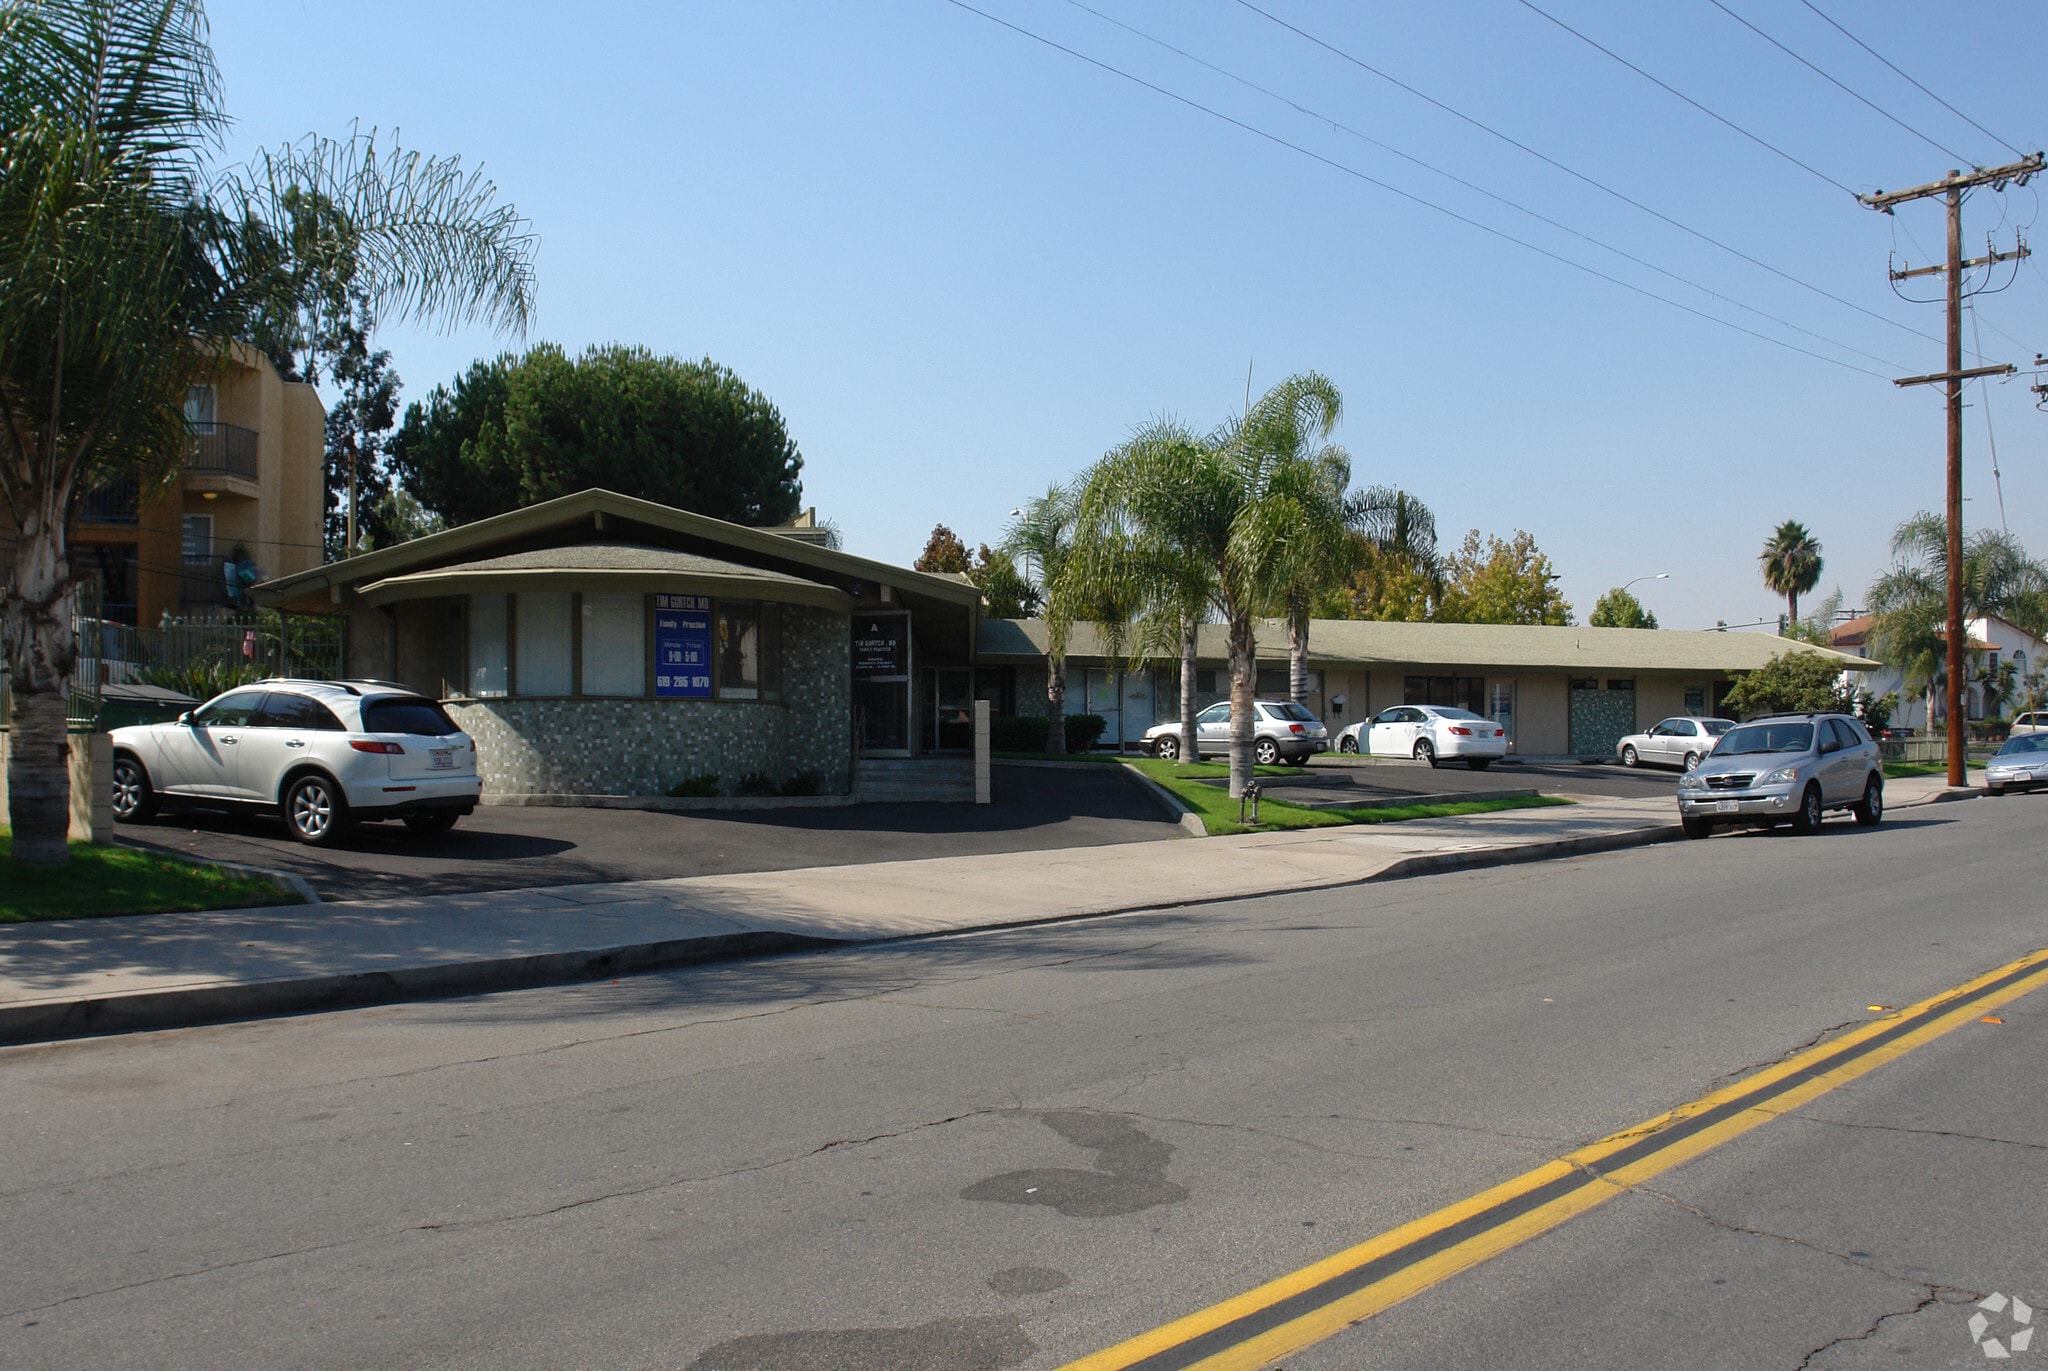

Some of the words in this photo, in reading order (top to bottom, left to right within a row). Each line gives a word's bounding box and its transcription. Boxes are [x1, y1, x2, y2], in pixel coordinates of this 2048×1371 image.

[656, 595, 669, 608] TIM
[698, 597, 710, 610] MD
[659, 619, 678, 629] Family
[682, 620, 707, 629] Practice
[871, 623, 879, 632] A
